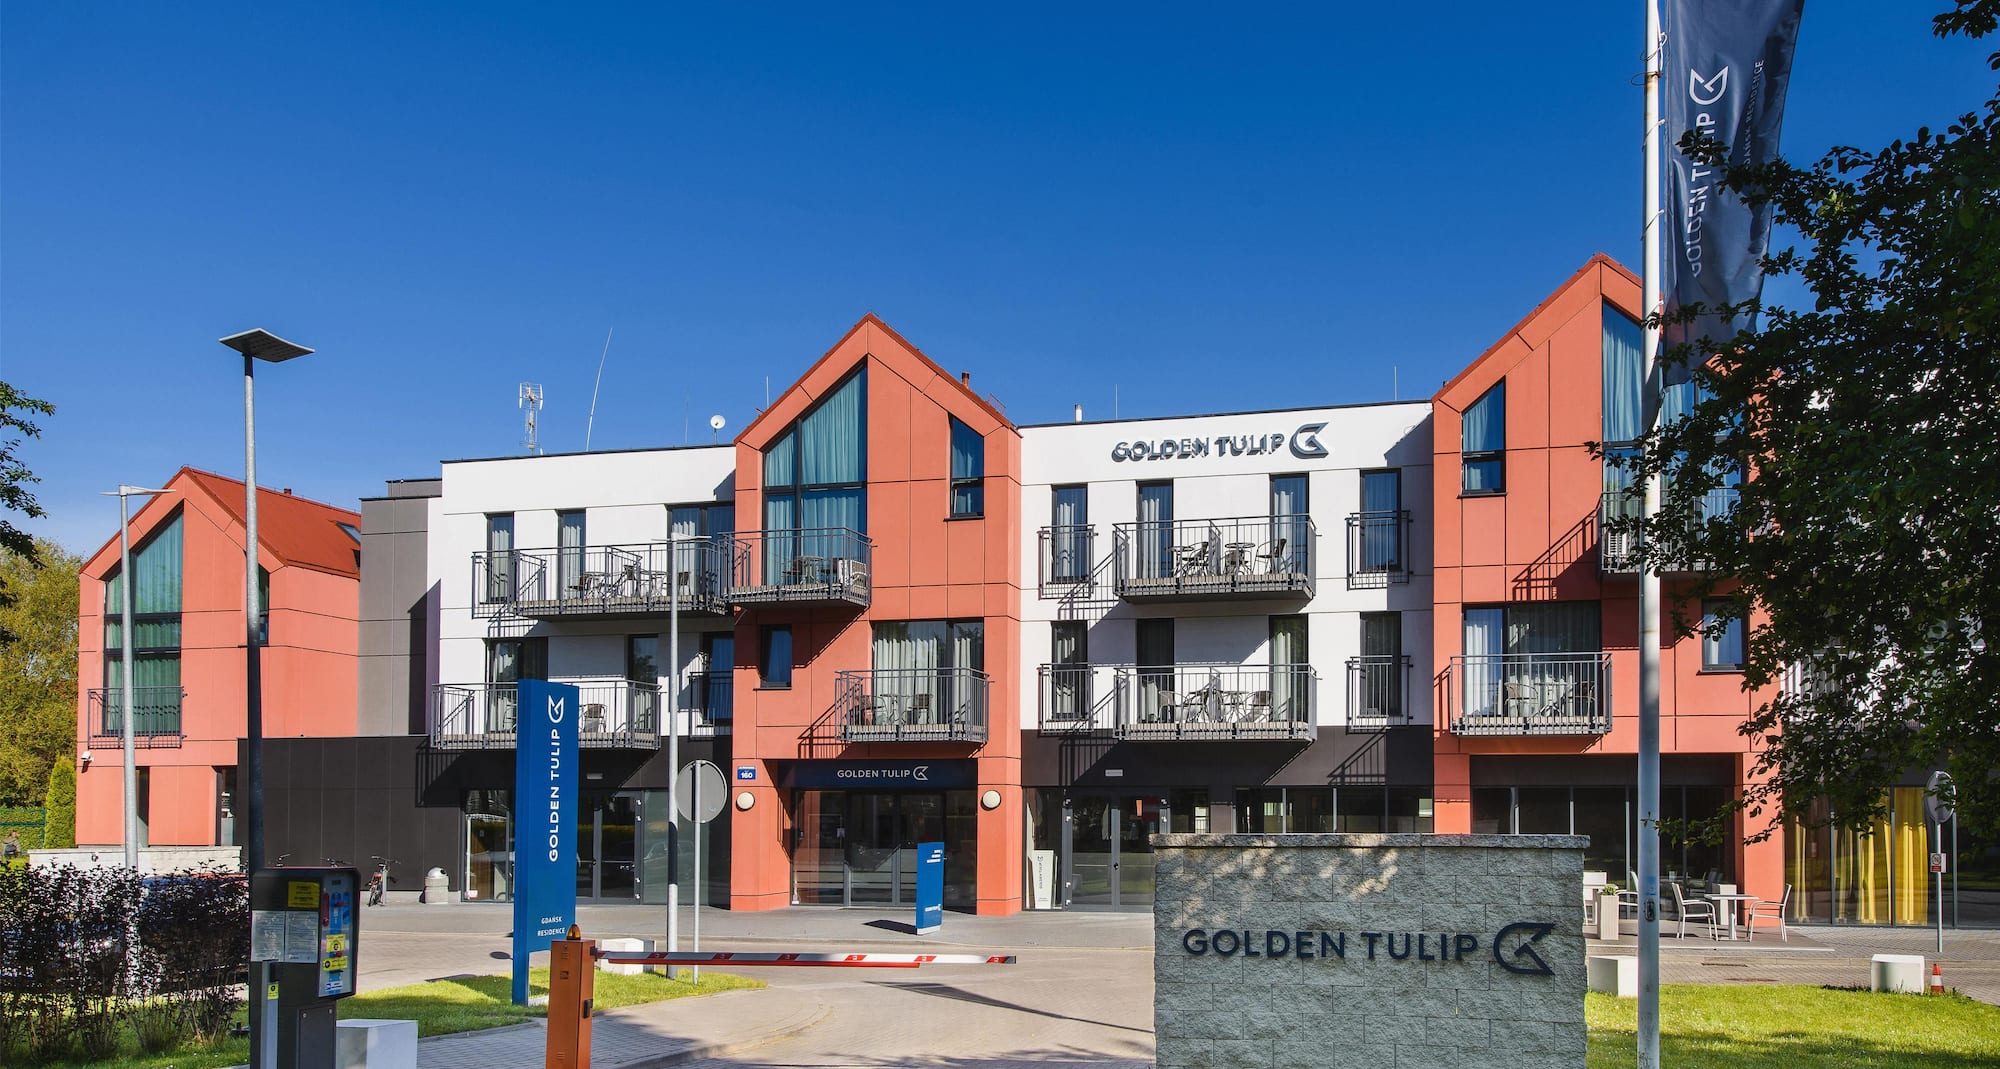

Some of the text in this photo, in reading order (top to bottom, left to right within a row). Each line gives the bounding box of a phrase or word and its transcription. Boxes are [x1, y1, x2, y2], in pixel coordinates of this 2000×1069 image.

[1111, 432, 1286, 463] GOLDEN TULIP
[837, 769, 911, 778] GOLDEN TULIP
[549, 728, 561, 862] GOLDEN TULIP
[537, 927, 565, 936] RESIDENCE
[1183, 928, 1479, 962] GOLDEN TULIP
